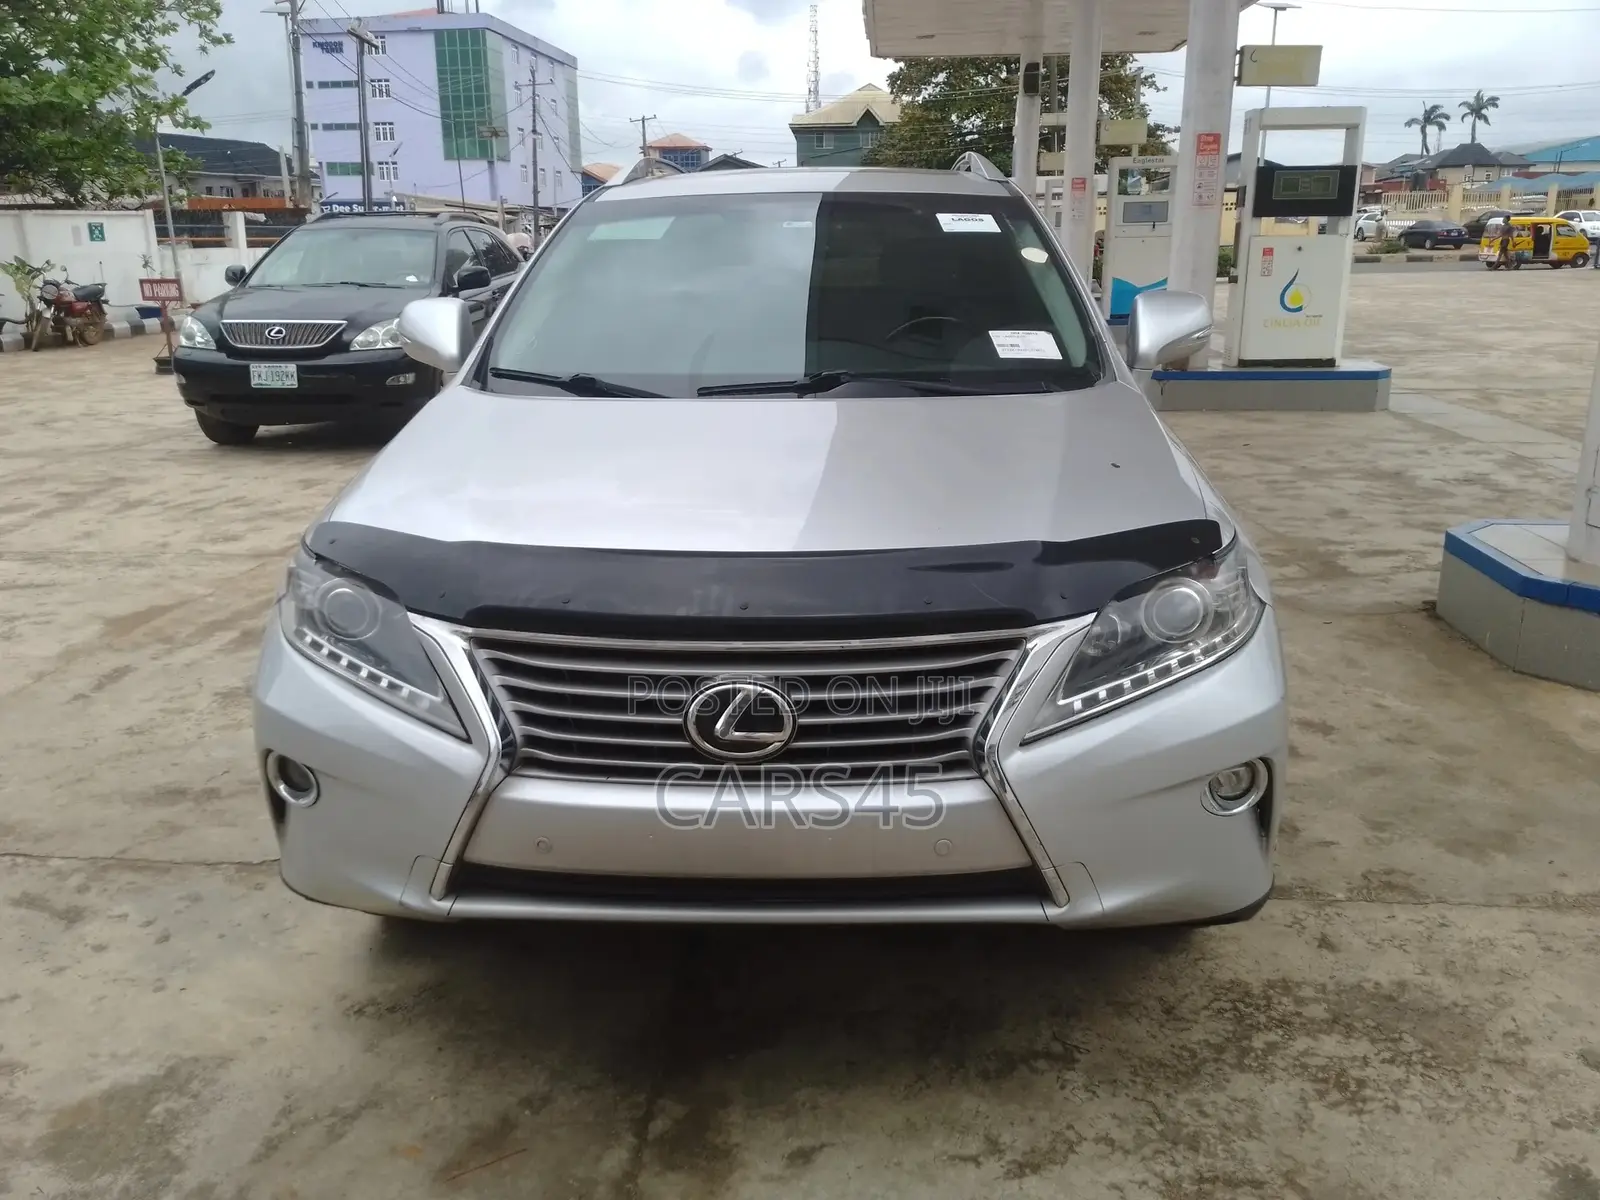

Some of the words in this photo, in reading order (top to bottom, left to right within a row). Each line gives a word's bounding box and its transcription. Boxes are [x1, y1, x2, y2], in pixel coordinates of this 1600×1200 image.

[332, 204, 350, 213] Dee
[143, 283, 153, 297] NO
[153, 283, 179, 297] PARKING
